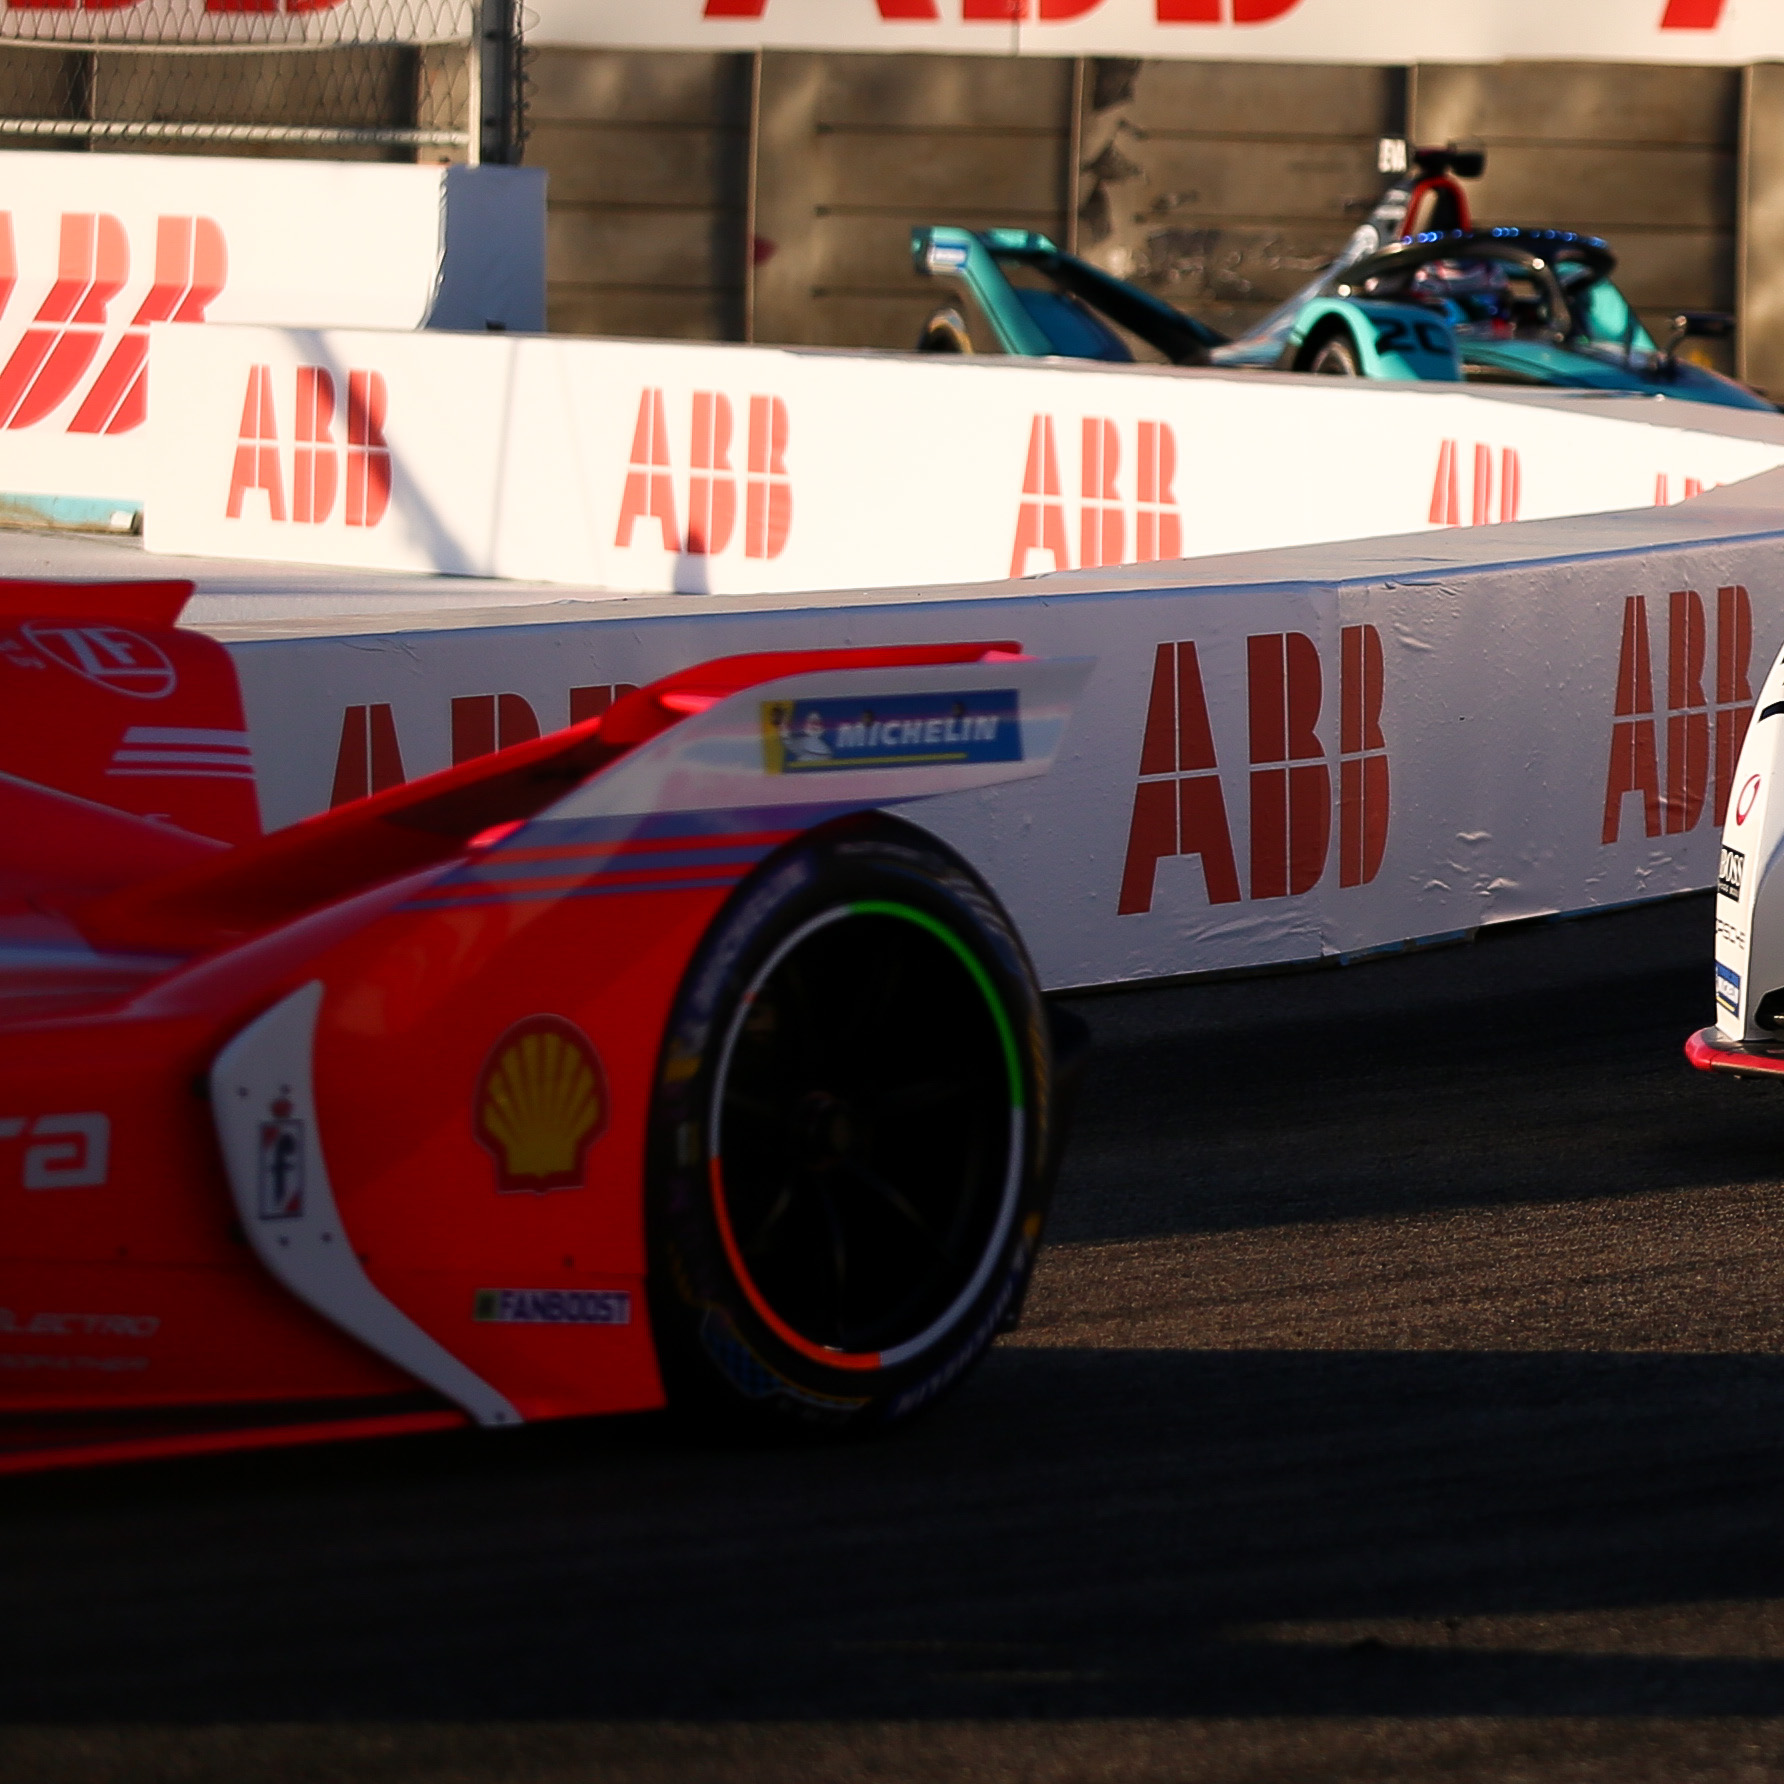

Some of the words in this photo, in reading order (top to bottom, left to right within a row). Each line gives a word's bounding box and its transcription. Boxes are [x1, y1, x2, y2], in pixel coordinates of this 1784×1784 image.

[226, 364, 392, 528] ABB
[614, 387, 793, 560] ABB
[1008, 413, 1184, 578] ABB
[835, 715, 1000, 748] MICHELIN
[1120, 624, 1389, 915] ABB
[1602, 584, 1753, 844] ABB
